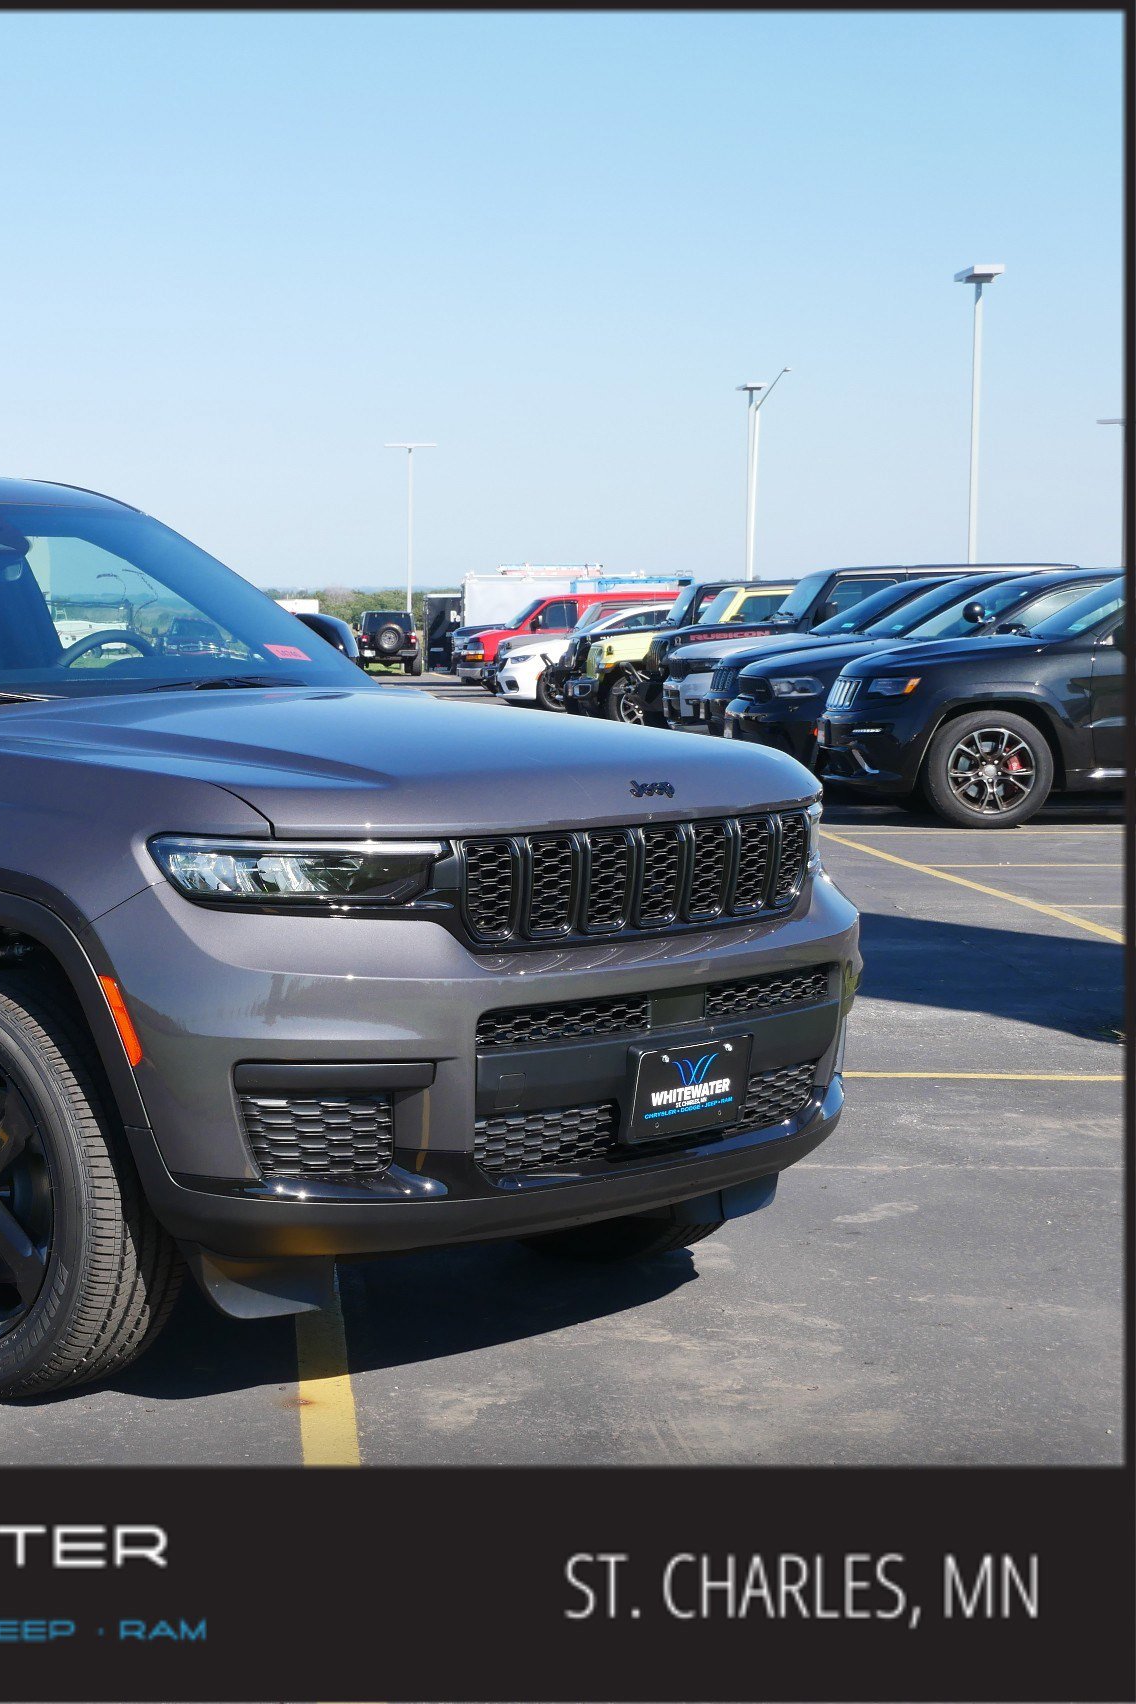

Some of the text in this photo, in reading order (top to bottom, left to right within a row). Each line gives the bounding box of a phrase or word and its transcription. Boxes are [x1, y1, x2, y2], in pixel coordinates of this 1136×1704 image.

[689, 630, 771, 642] RUBICON
[629, 779, 676, 799] Jeep
[651, 1077, 731, 1107] WHITEWATER
[644, 1096, 733, 1119] CHRYSLER DODGE JEEP RAM
